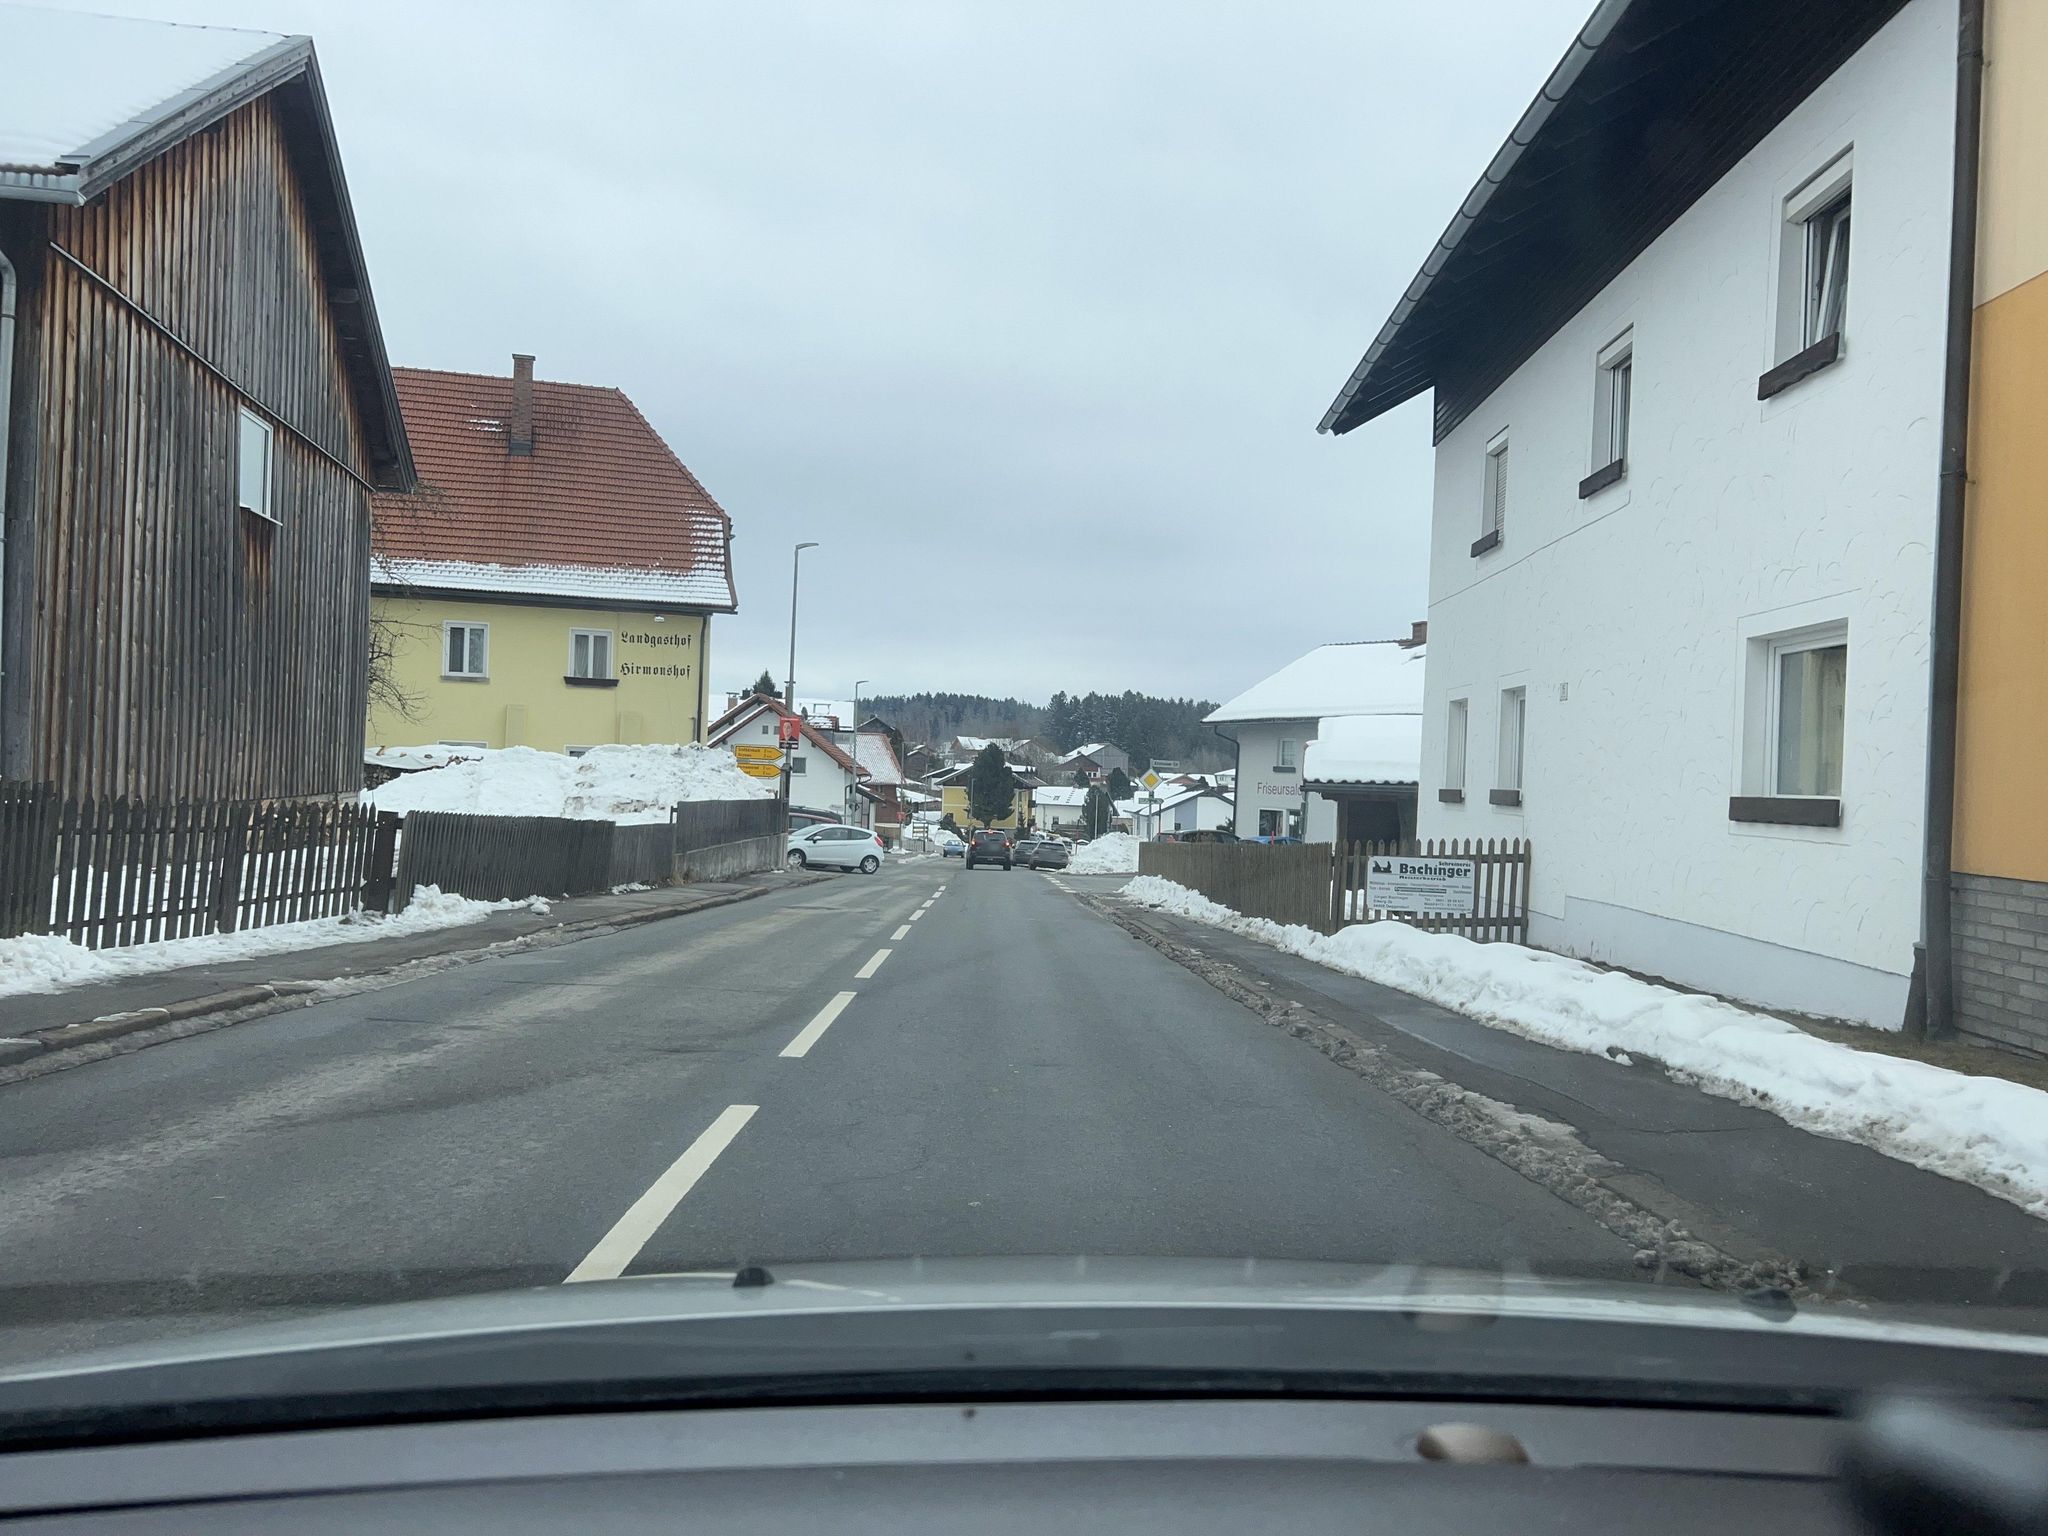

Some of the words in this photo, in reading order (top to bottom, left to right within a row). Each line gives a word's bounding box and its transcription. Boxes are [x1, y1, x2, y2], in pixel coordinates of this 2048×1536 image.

[621, 630, 692, 649] Landgasthof
[620, 662, 691, 680] Hirmonshof
[1257, 782, 1302, 796] Friseursalo
[1399, 863, 1471, 878] Bachinger
